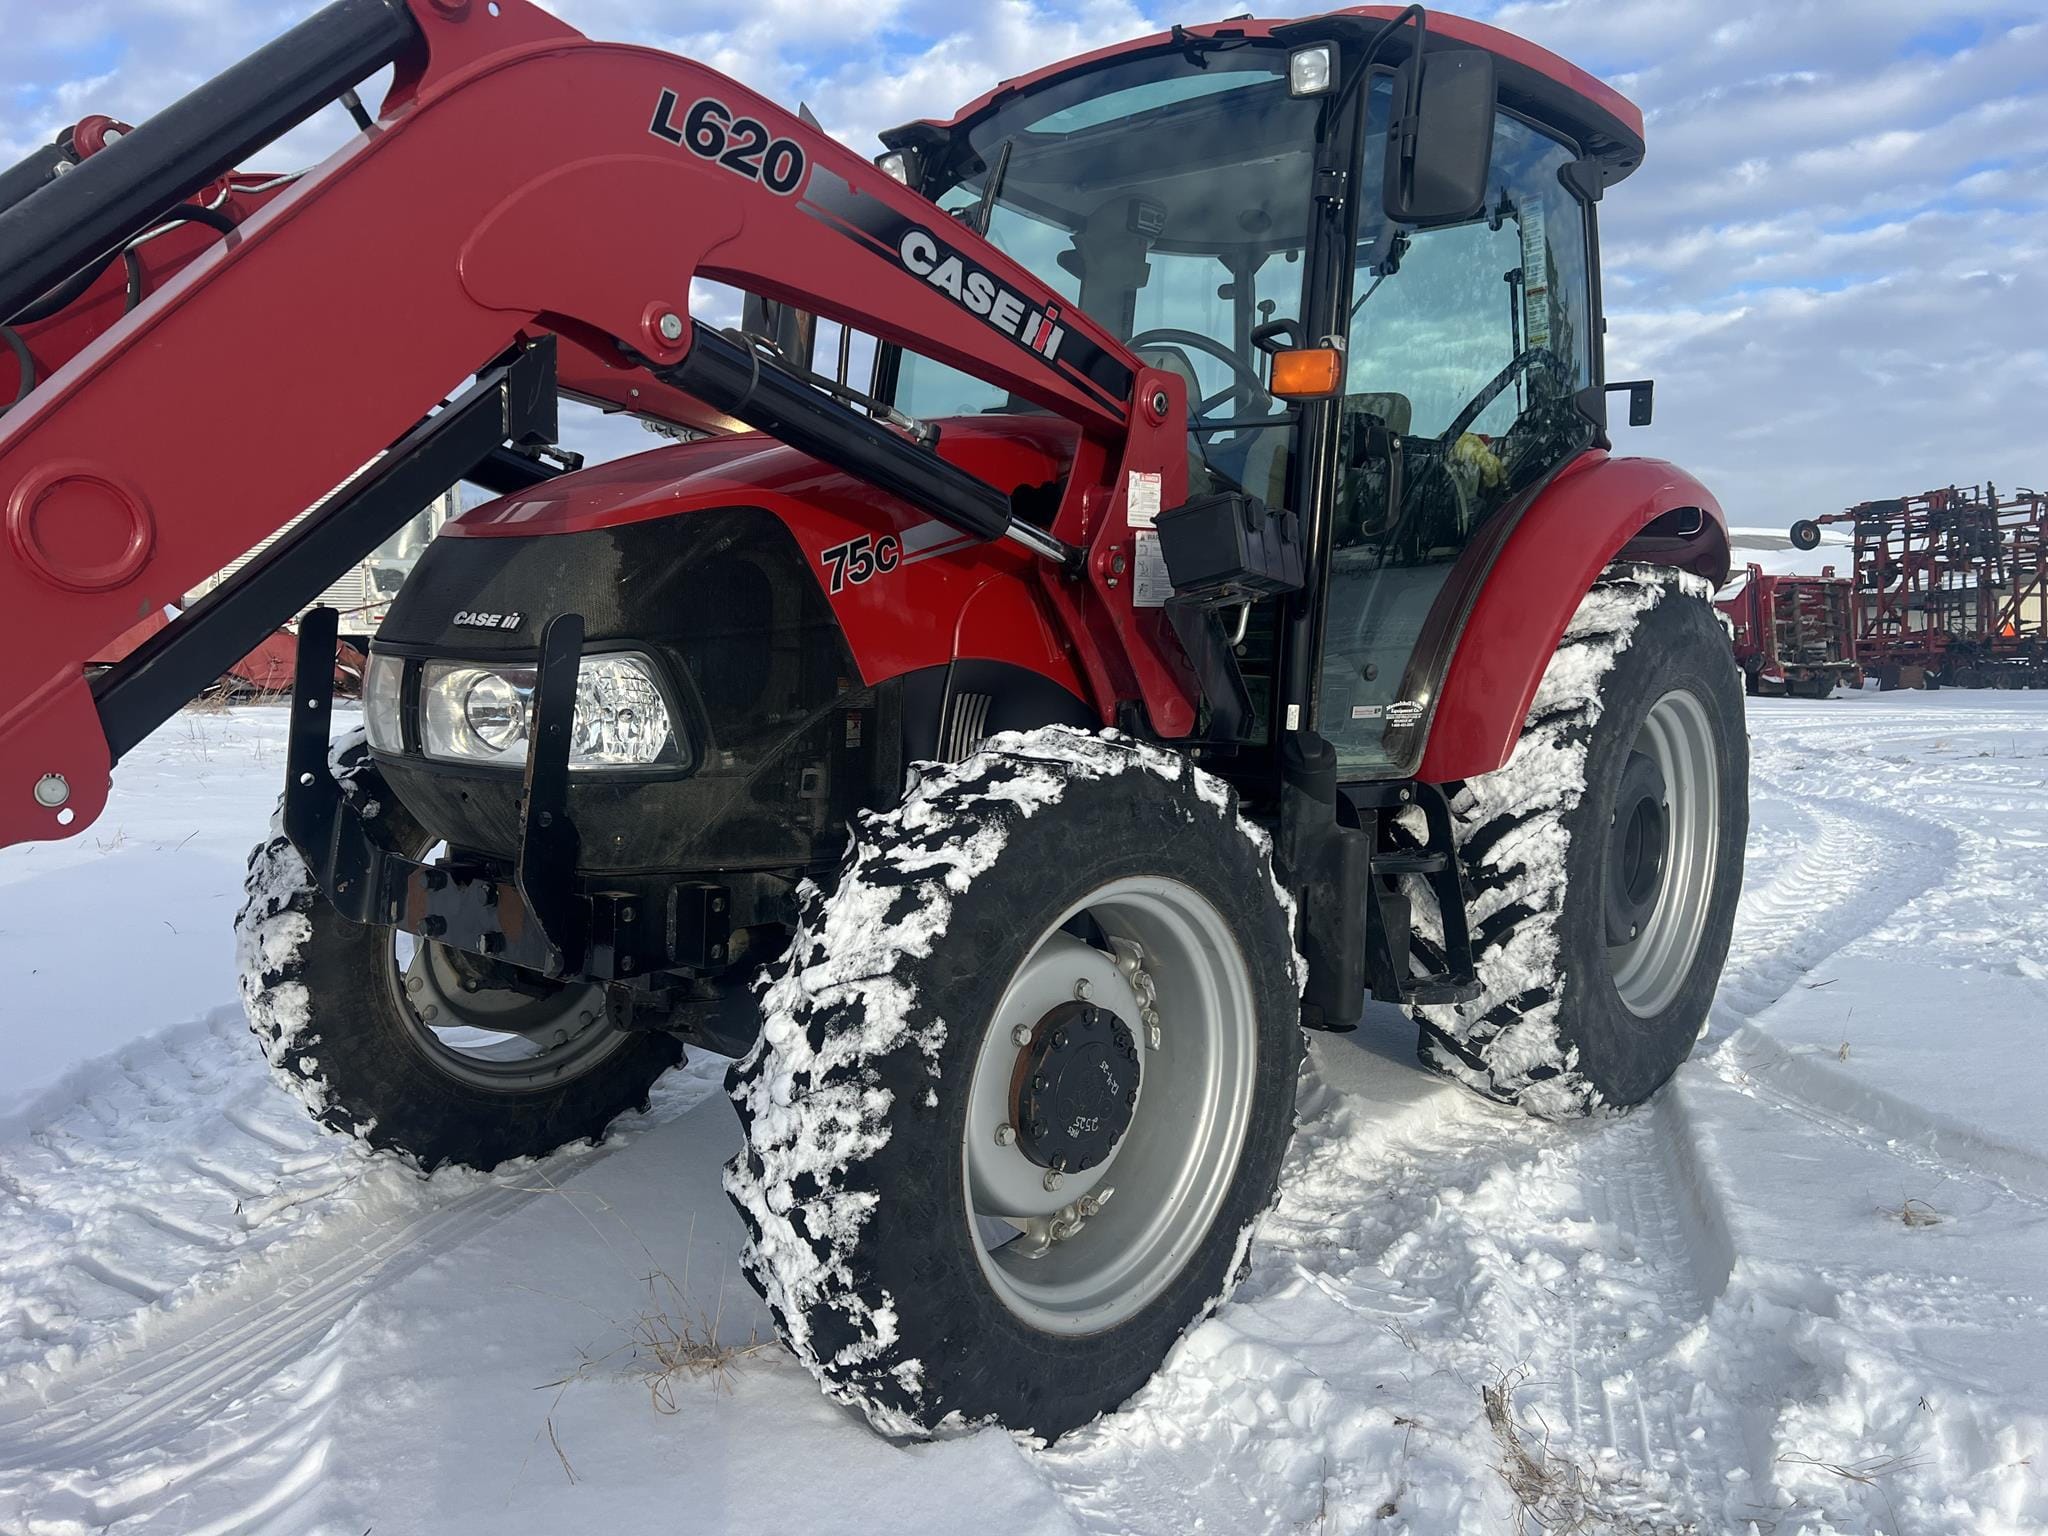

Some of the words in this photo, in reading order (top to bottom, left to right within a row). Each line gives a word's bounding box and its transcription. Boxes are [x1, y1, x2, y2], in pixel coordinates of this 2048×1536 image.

[649, 88, 807, 197] L620
[900, 230, 1028, 337] CASE
[821, 533, 899, 595] 75C
[453, 610, 502, 627] CASE
[1073, 1116, 1098, 1132] 2525
